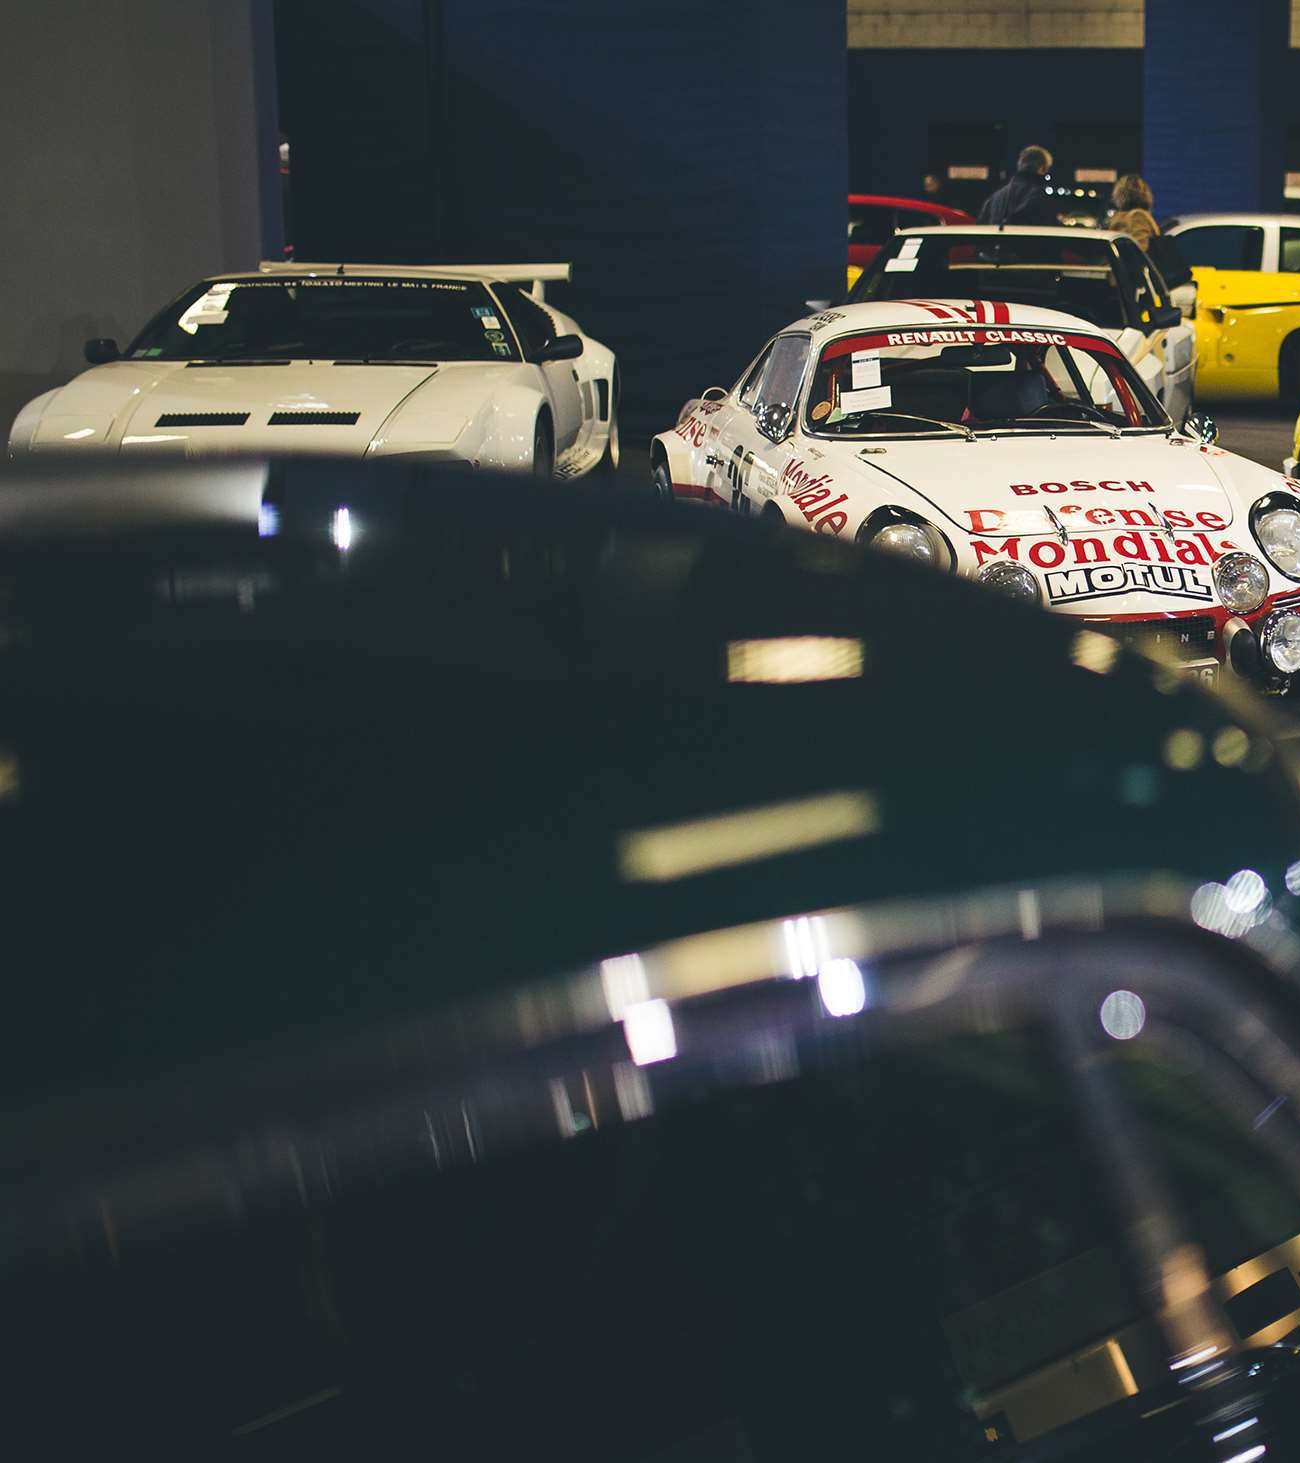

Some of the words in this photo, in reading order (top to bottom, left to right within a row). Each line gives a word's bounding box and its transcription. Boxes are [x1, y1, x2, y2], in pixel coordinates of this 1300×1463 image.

[887, 331, 976, 346] RENAULT
[984, 331, 1067, 346] CLASSIC
[1009, 479, 1156, 496] BOSCH
[969, 531, 1239, 569] Mondial
[1045, 562, 1214, 604] MOTUL
